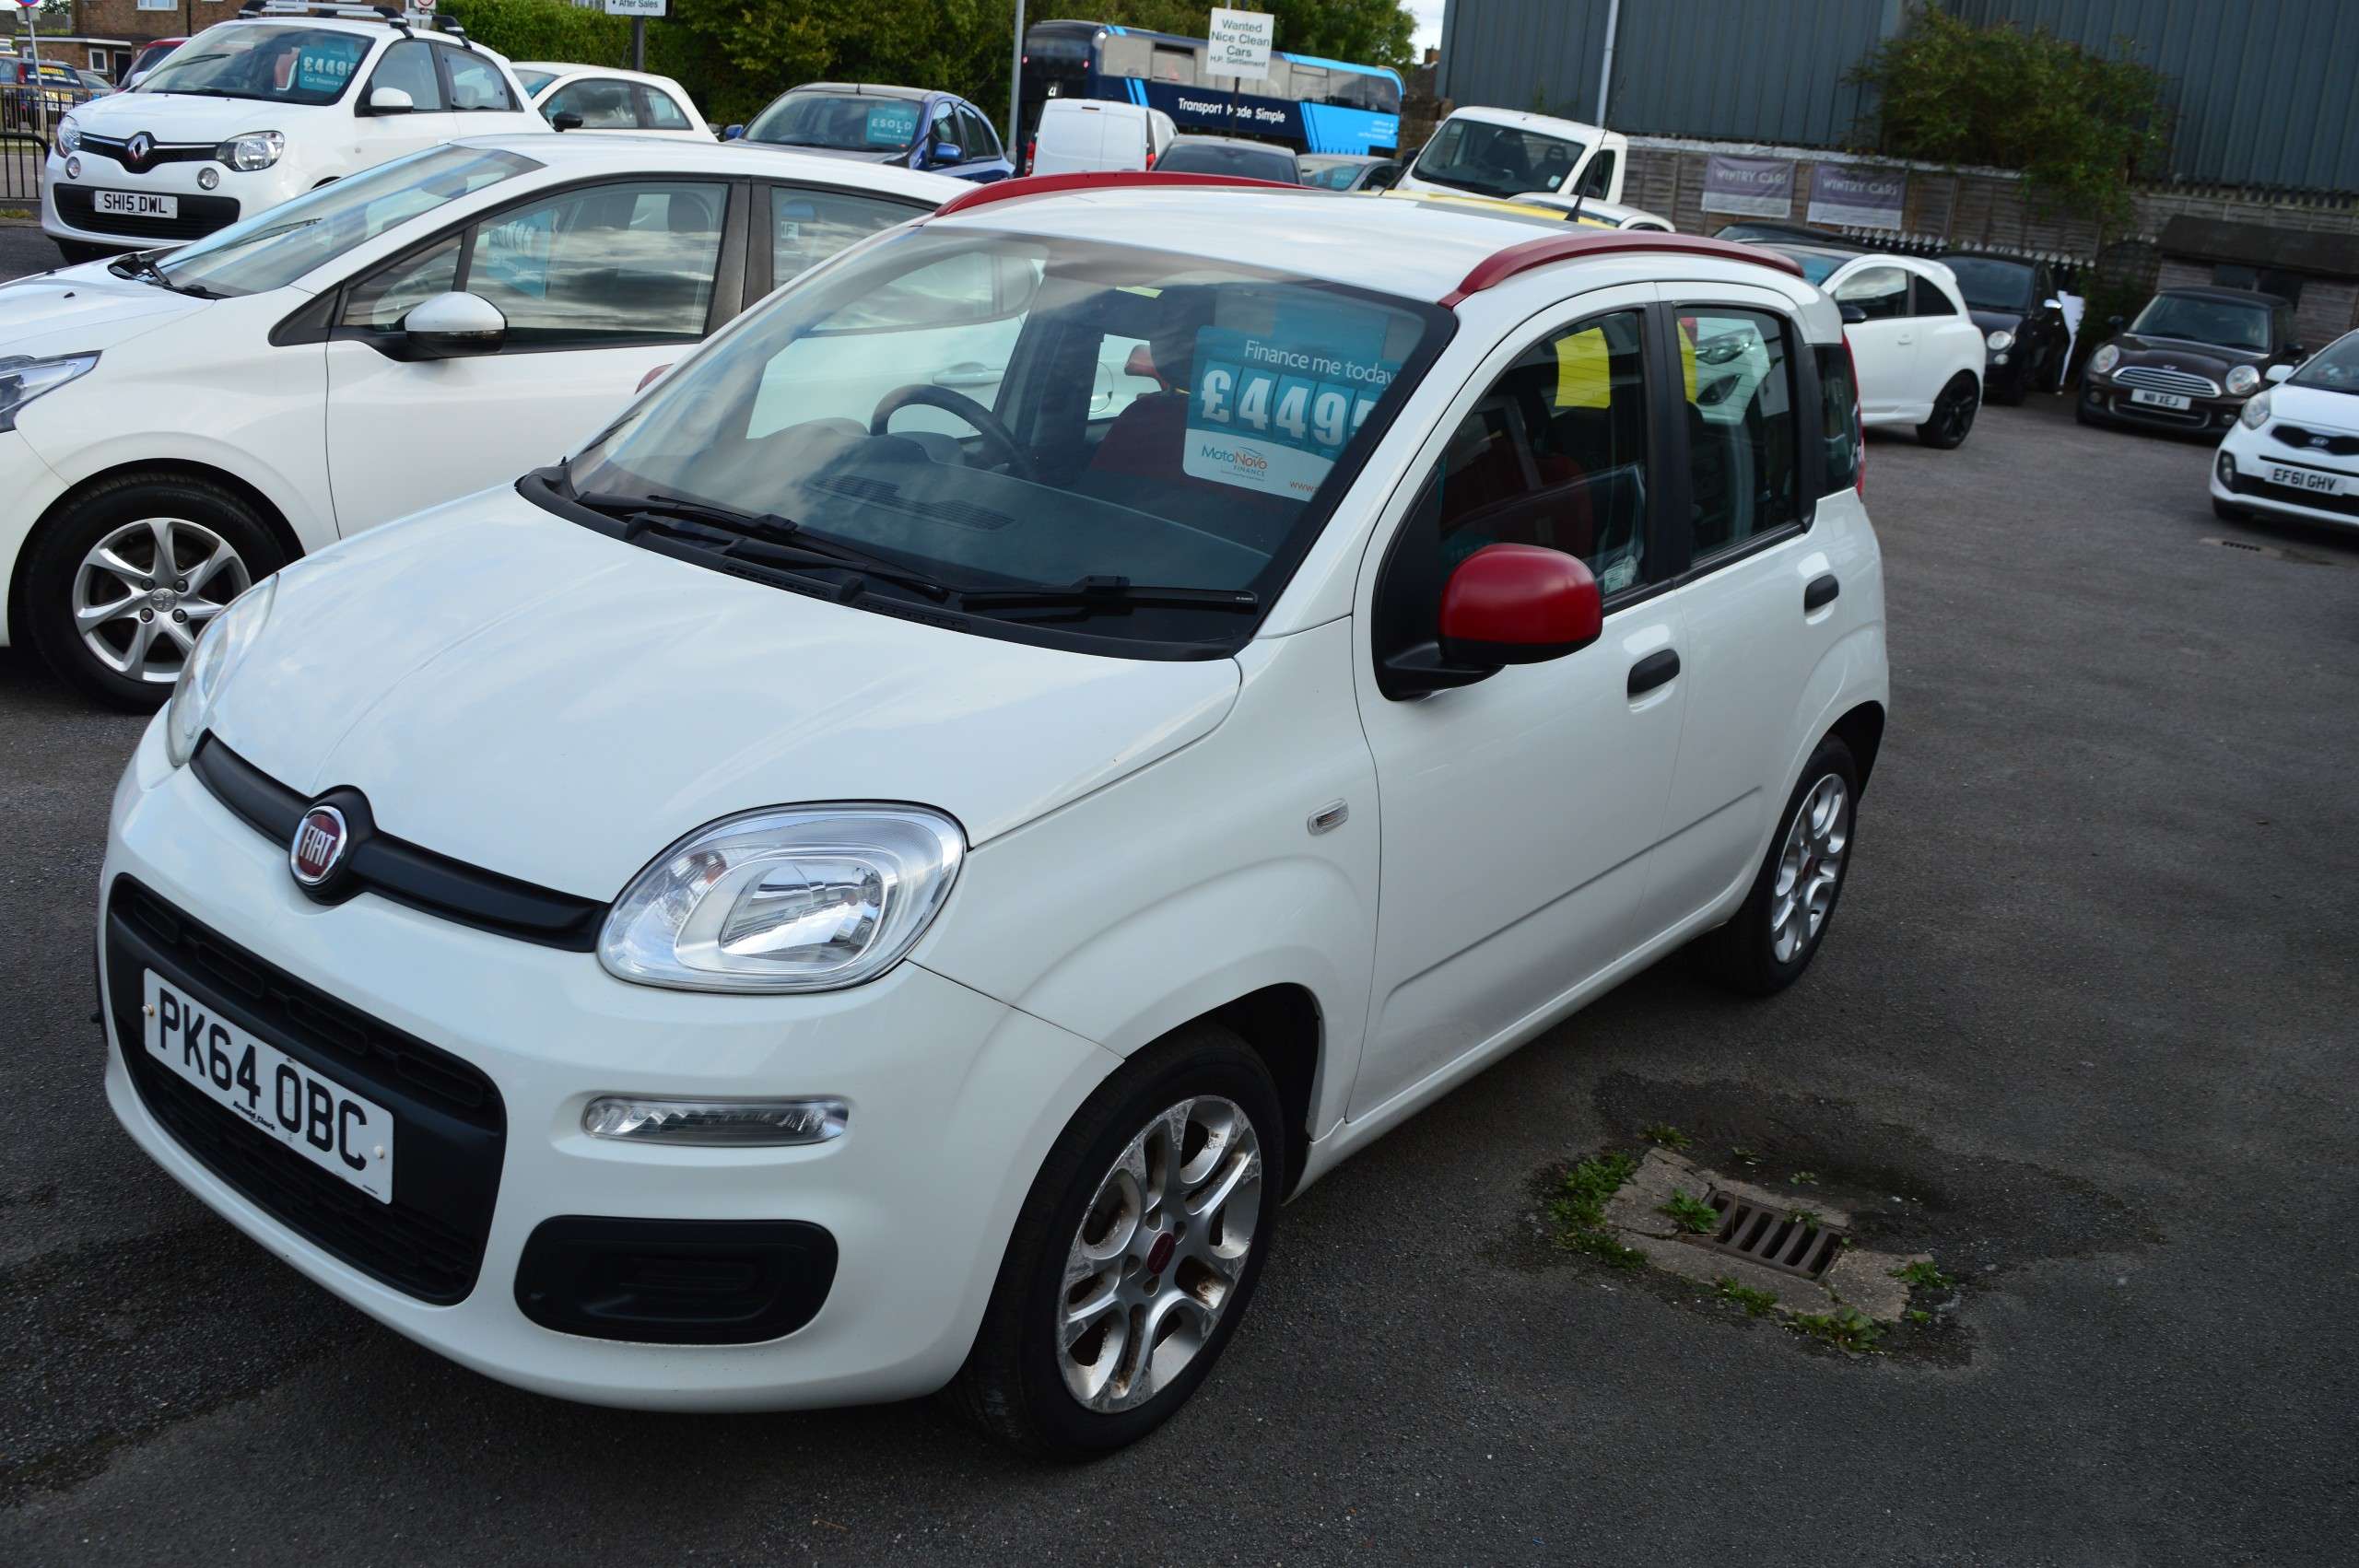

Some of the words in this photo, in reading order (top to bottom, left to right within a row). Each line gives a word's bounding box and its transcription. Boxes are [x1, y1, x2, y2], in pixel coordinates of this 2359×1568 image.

[638, 0, 658, 8] Sales
[1222, 18, 1262, 33] Wanted
[1211, 30, 1235, 42] Nice
[1238, 33, 1270, 47] Clean
[1226, 44, 1252, 57] Cars
[1178, 97, 1223, 115] Transport
[1255, 107, 1285, 124] Simple
[103, 193, 135, 211] SH15
[138, 195, 168, 214] DWL
[1245, 339, 1309, 369] Finance
[1312, 357, 1341, 376] me
[1345, 360, 1398, 391] today
[1202, 445, 1268, 470] MotoNovo
[1233, 465, 1265, 478] FINANCE
[2272, 468, 2306, 486] EF61
[2306, 474, 2337, 492] GHV
[299, 825, 337, 867] FIAT
[159, 987, 261, 1110] PK64
[276, 1062, 368, 1172] OBC
